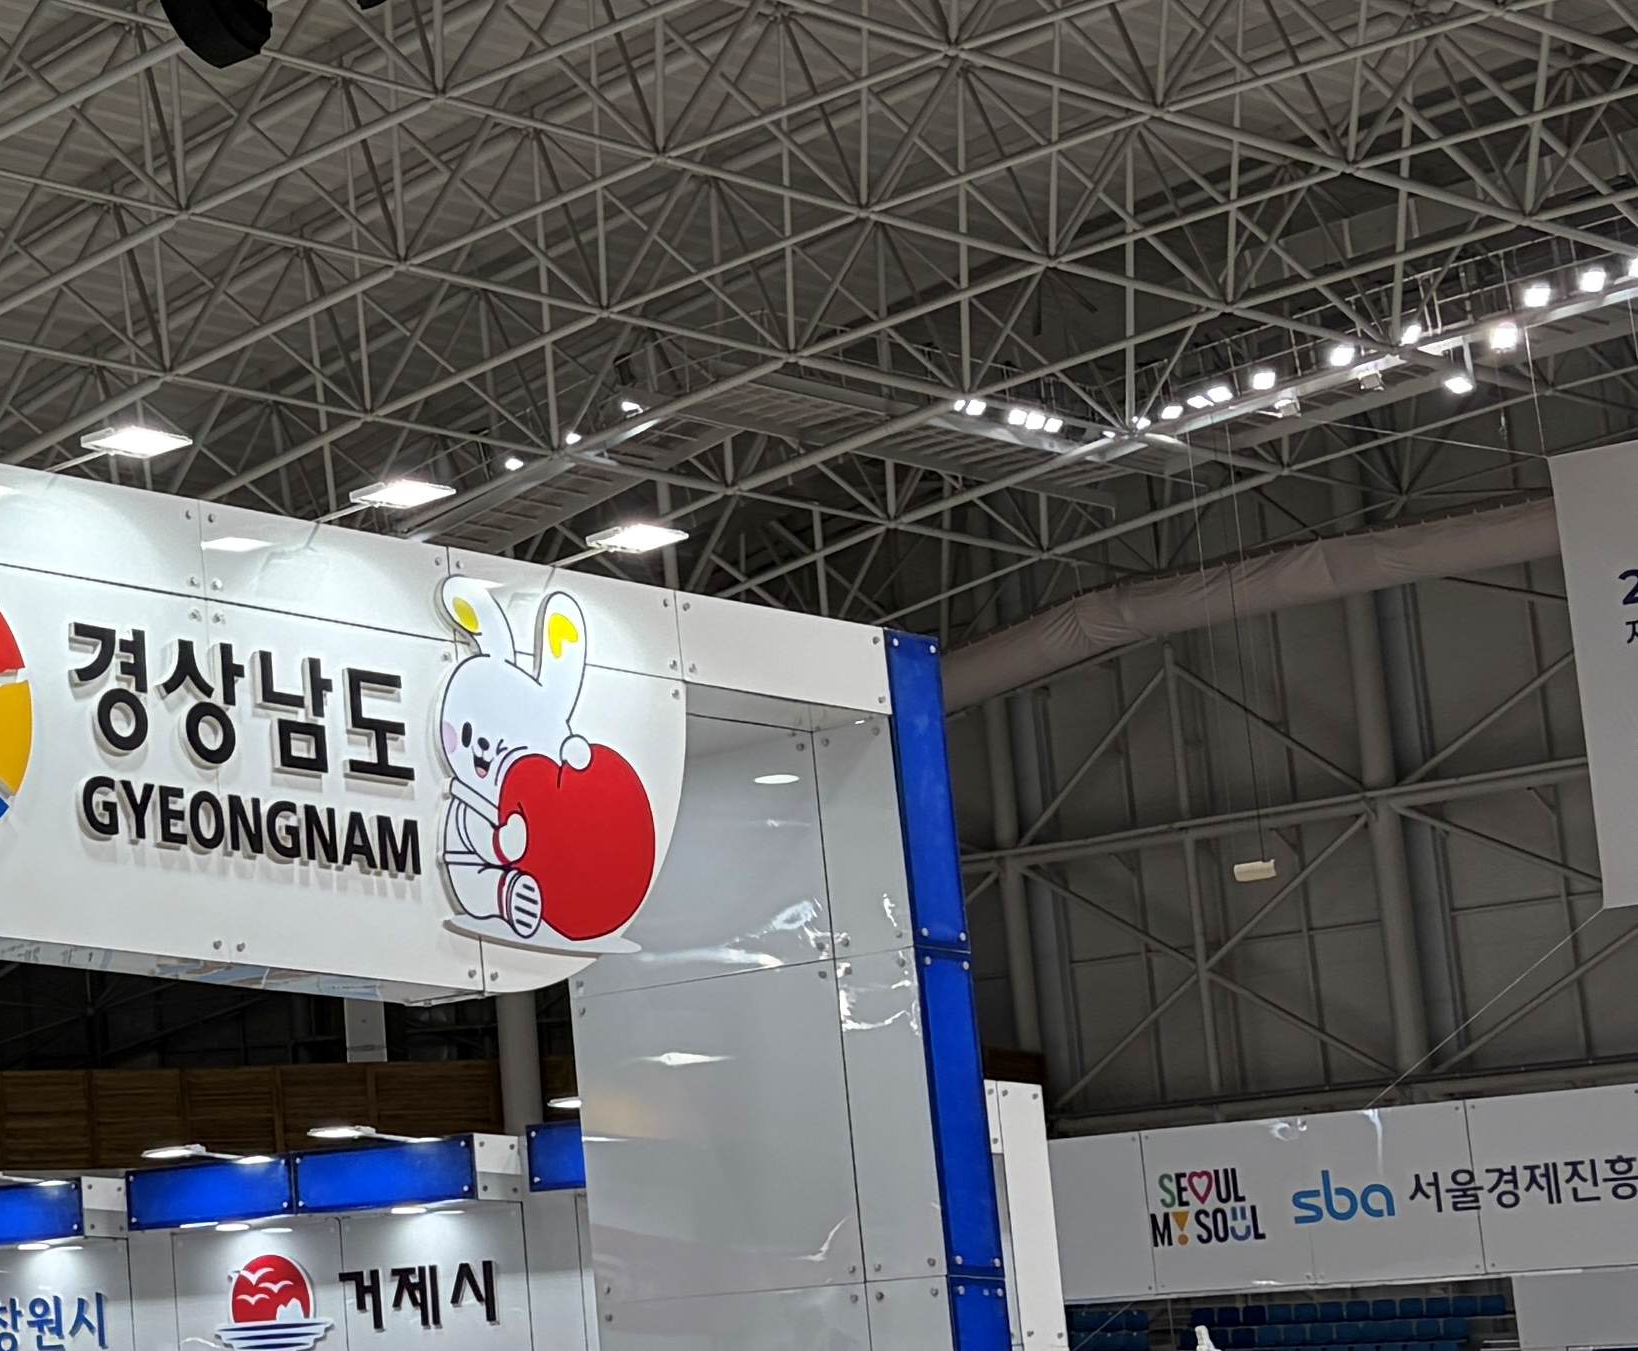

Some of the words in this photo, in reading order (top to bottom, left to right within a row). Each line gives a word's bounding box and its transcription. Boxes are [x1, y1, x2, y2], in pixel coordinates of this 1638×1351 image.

[68, 622, 415, 781] 경상남도
[80, 775, 421, 876] GYEONGNAM
[1292, 1169, 1396, 1224] sba
[339, 1261, 498, 1331] 거제시
